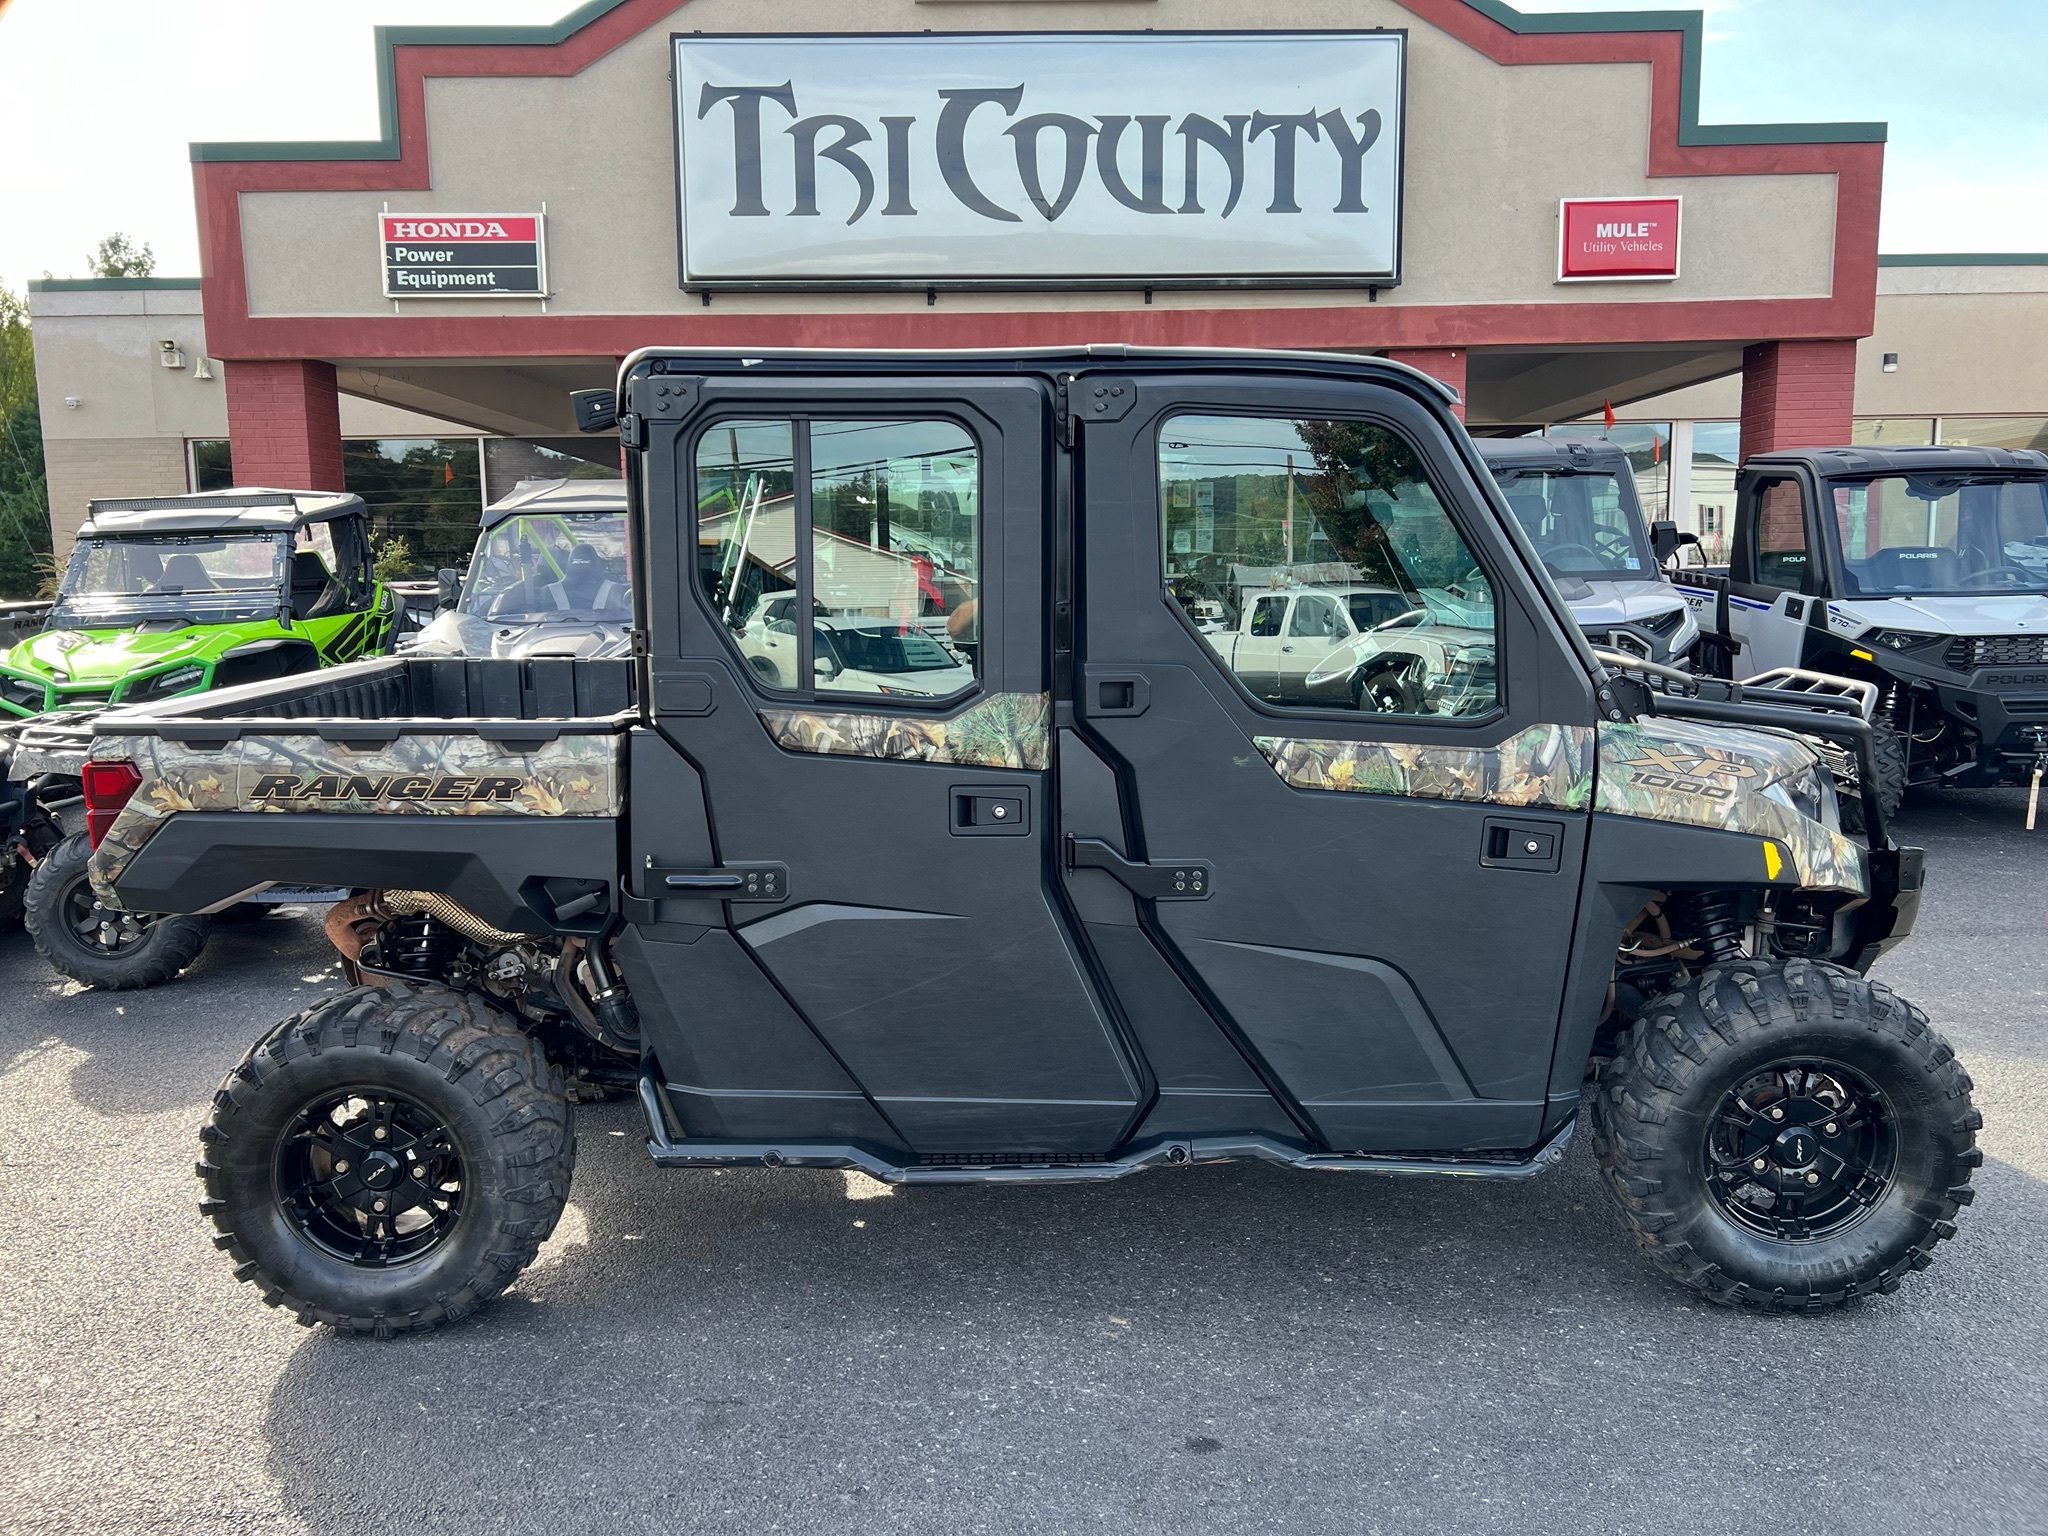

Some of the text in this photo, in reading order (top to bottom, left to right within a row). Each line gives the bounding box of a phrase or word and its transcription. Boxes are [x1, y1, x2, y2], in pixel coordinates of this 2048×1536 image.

[393, 222, 509, 238] HONDA
[395, 247, 454, 262] Power
[1583, 241, 1663, 254] Utility Vehicles
[397, 270, 496, 288] Equipment
[1899, 552, 1938, 560] POLARIS
[13, 616, 52, 630] RANG
[1986, 674, 2048, 685] POLAR
[1612, 745, 1758, 779] XP
[246, 773, 524, 801] RANGER
[1629, 772, 1733, 799] 1000
